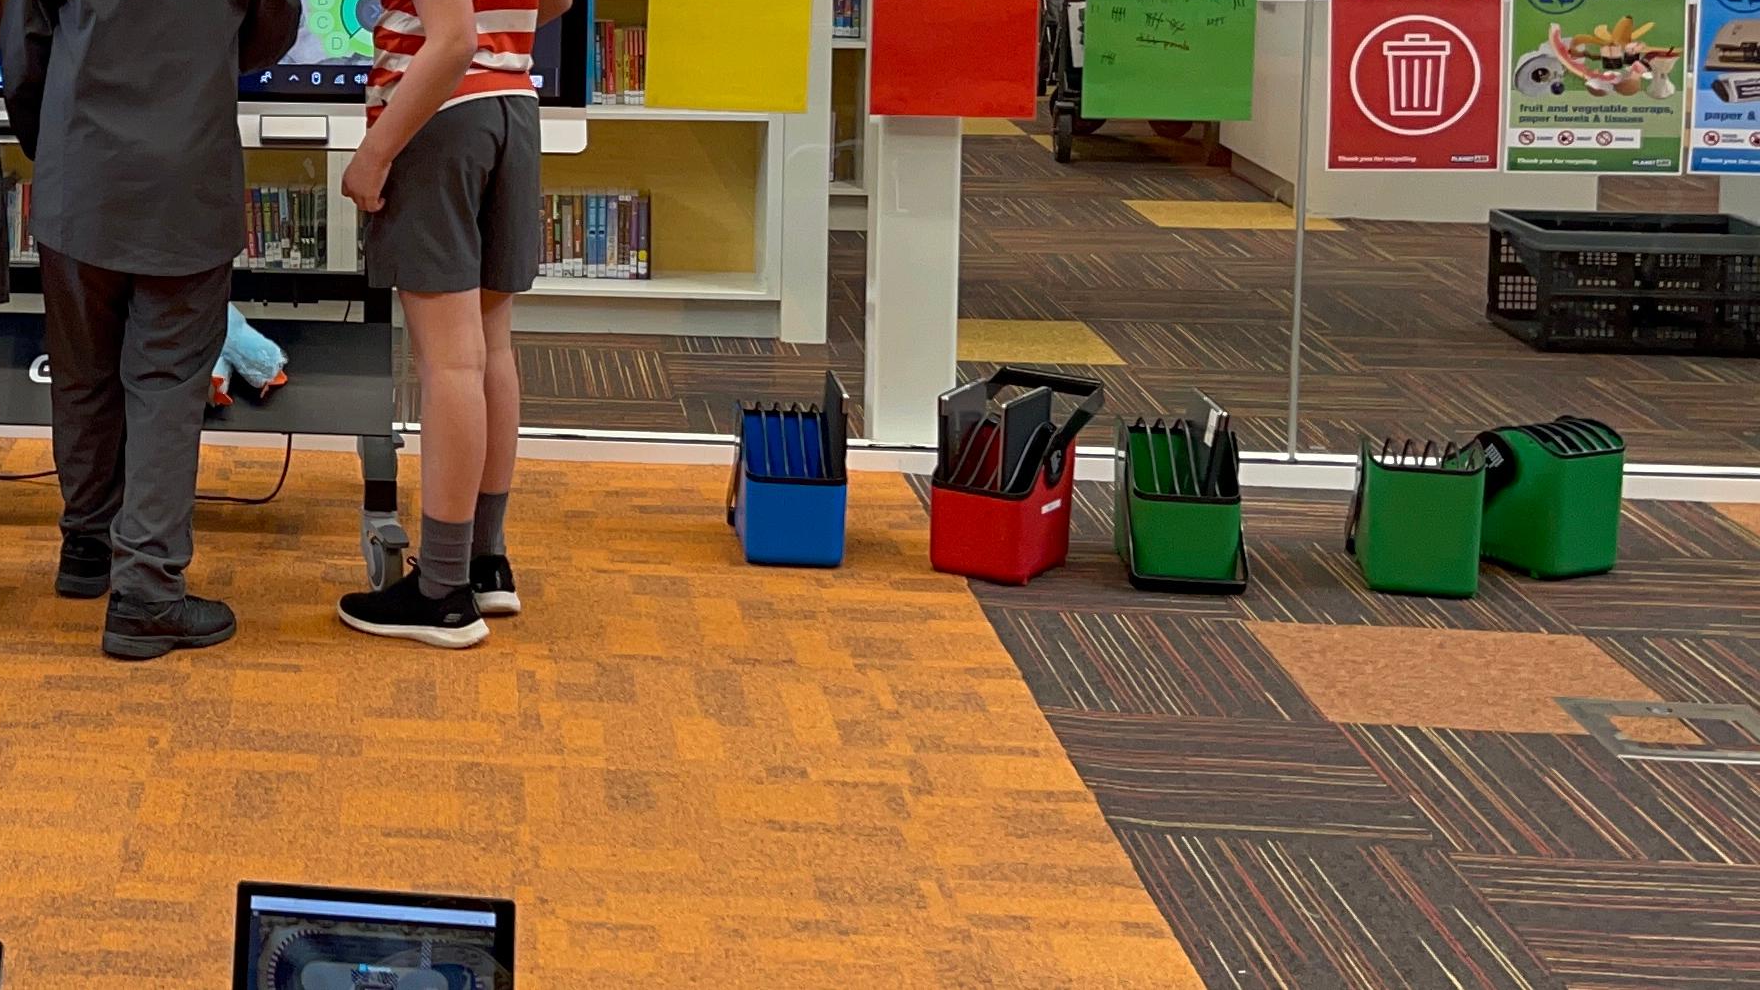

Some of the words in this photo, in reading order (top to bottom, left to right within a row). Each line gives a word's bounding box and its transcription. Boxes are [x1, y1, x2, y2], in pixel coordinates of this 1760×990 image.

[1519, 104, 1544, 113] fruit
[1547, 104, 1569, 113] and
[1572, 105, 1628, 115] vegetable
[1631, 105, 1674, 115] scraps,
[1519, 116, 1550, 124] paper
[1604, 115, 1644, 123] tissues
[1704, 111, 1743, 122] paper
